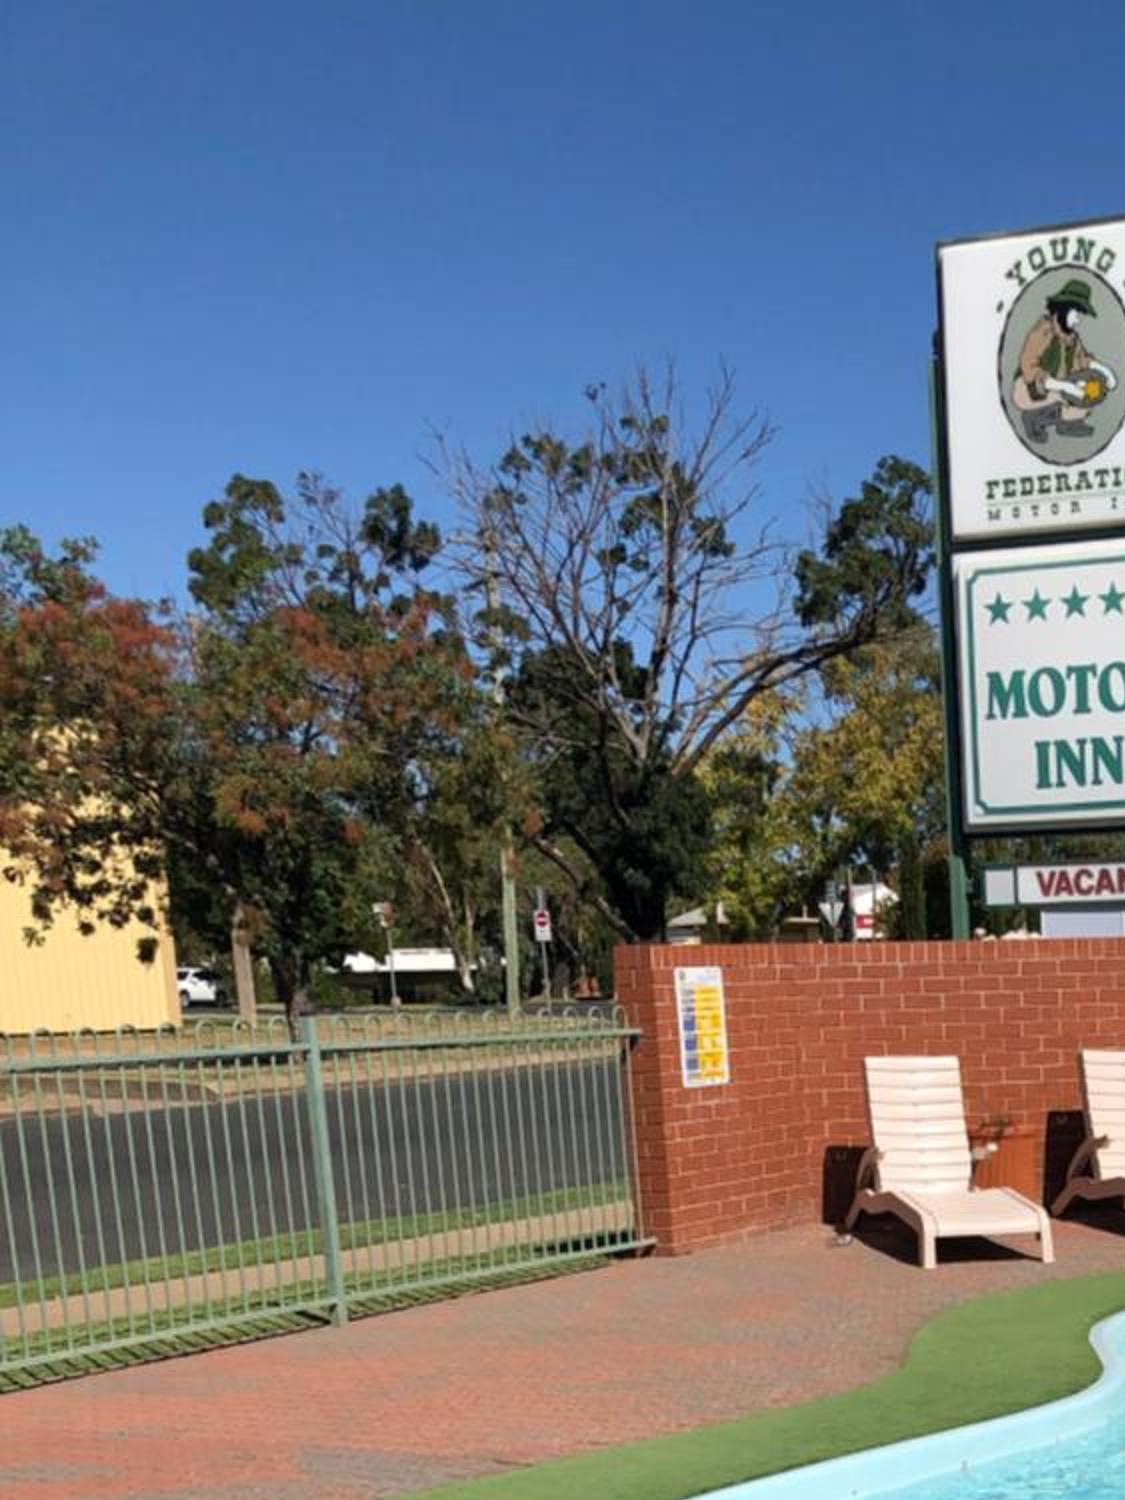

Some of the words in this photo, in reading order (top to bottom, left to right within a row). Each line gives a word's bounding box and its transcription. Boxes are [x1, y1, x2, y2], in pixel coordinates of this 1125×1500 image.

[1006, 237, 1116, 287] YOUNG
[988, 501, 1080, 521] MOTOR
[1034, 735, 1125, 790] INN
